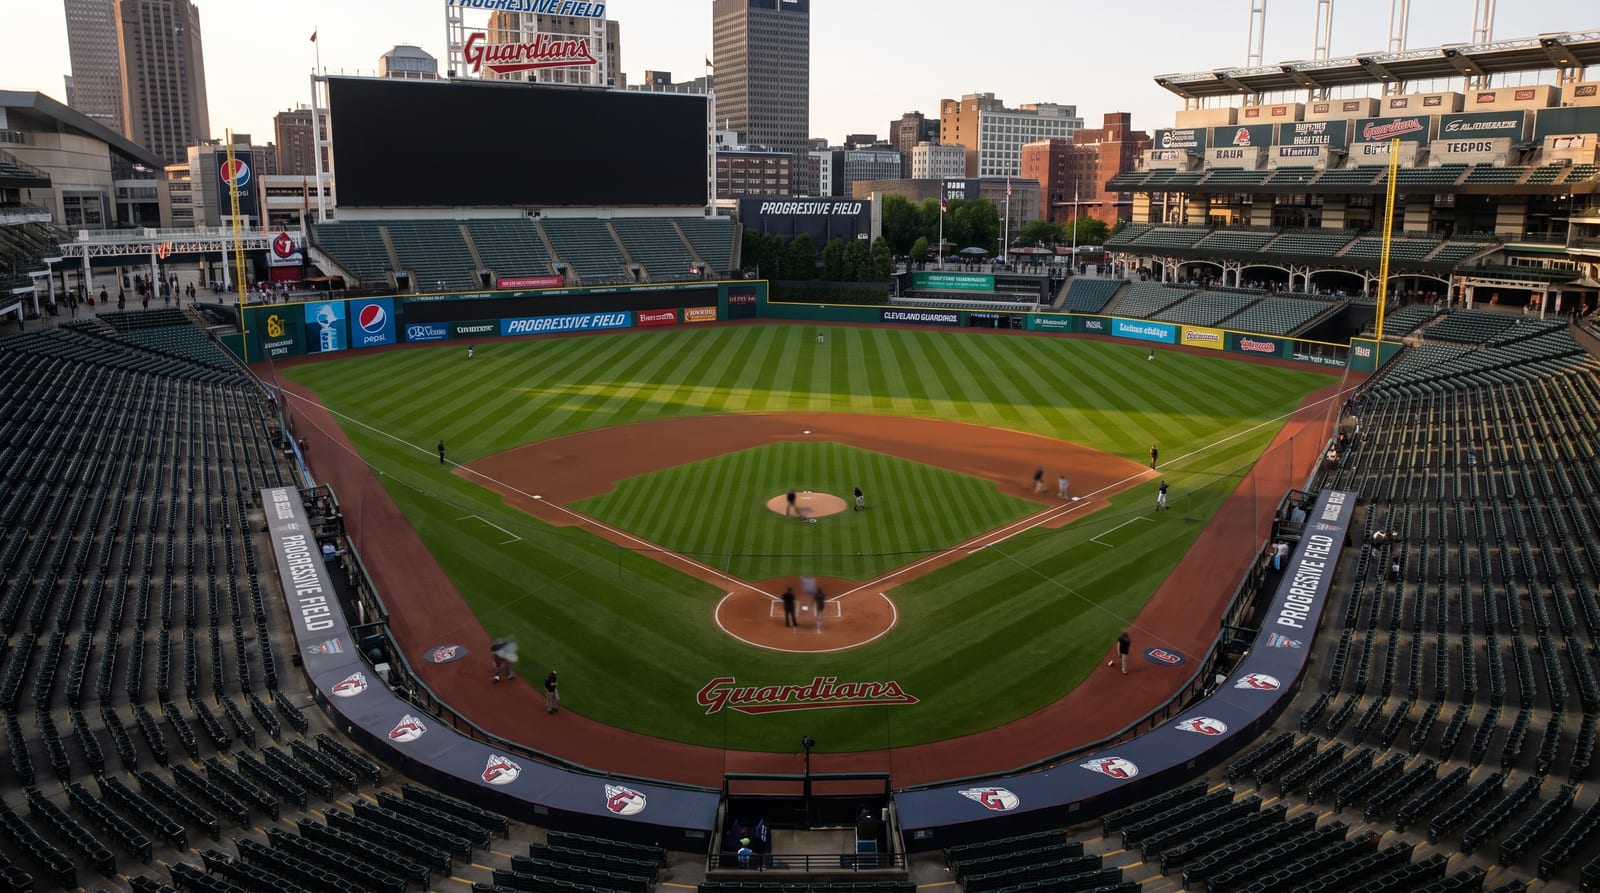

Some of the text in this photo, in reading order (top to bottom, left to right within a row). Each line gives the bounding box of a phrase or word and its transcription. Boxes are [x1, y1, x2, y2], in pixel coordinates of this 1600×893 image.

[561, 3, 605, 17] FIELD
[464, 32, 597, 74] Guardians
[760, 202, 862, 215] PROGRESSIVE FIELD
[507, 315, 591, 333] PROGRESSIVE
[591, 313, 625, 328] FIELD
[884, 311, 921, 321] CLEVELAND
[1304, 535, 1333, 560] FIELD
[281, 534, 322, 596] PROGRESSIVE
[299, 595, 334, 632] FIELD
[697, 677, 920, 715] Guardians
